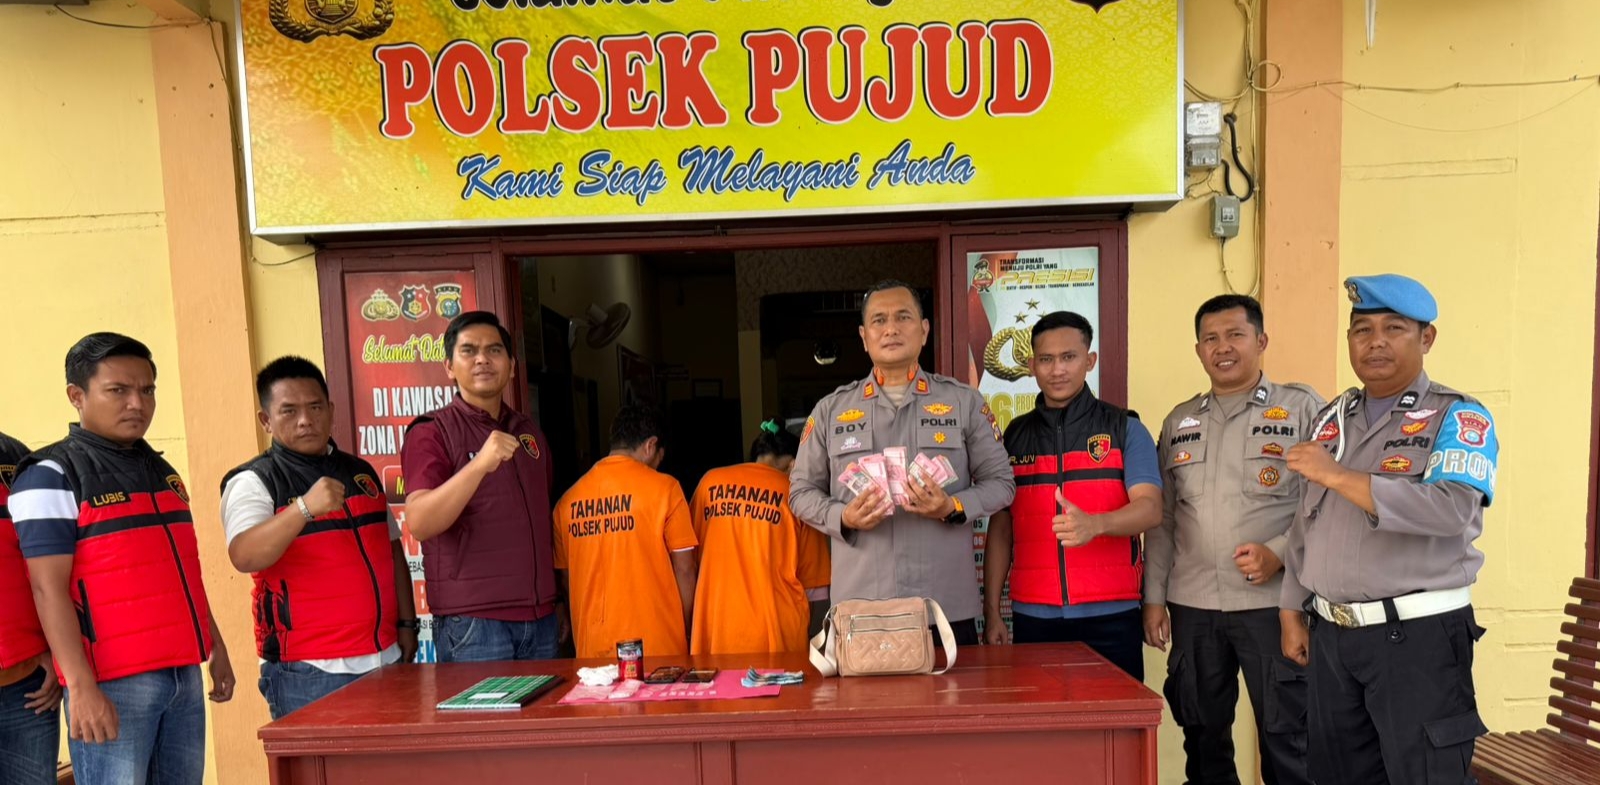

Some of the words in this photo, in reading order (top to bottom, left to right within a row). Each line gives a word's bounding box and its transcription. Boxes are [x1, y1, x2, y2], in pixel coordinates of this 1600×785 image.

[374, 31, 728, 139] POLSEK
[743, 19, 1054, 126] PUJUD
[457, 152, 565, 200] Kami
[577, 148, 667, 205] Siap
[679, 144, 860, 202] Melayani
[867, 139, 976, 190] Anda
[1000, 257, 1044, 265] TRANSFORMASI
[1001, 268, 1095, 285] PRESISI
[362, 335, 417, 364] Selamat
[373, 387, 389, 417] DI
[835, 422, 867, 435] BOY
[921, 417, 957, 427] POLRI
[1252, 425, 1294, 437] POLRI
[359, 425, 397, 455] ZONA
[1384, 436, 1430, 451] POLRI
[1019, 454, 1035, 464] JUV
[93, 491, 126, 506] LUBIS
[708, 484, 783, 507] TAHANAN
[570, 494, 632, 519] TAHANAN
[704, 502, 741, 521] POLSEK
[744, 504, 782, 525] PUJUD
[604, 515, 635, 533] PUJUD
[973, 519, 983, 529] 05
[974, 552, 983, 562] 07
